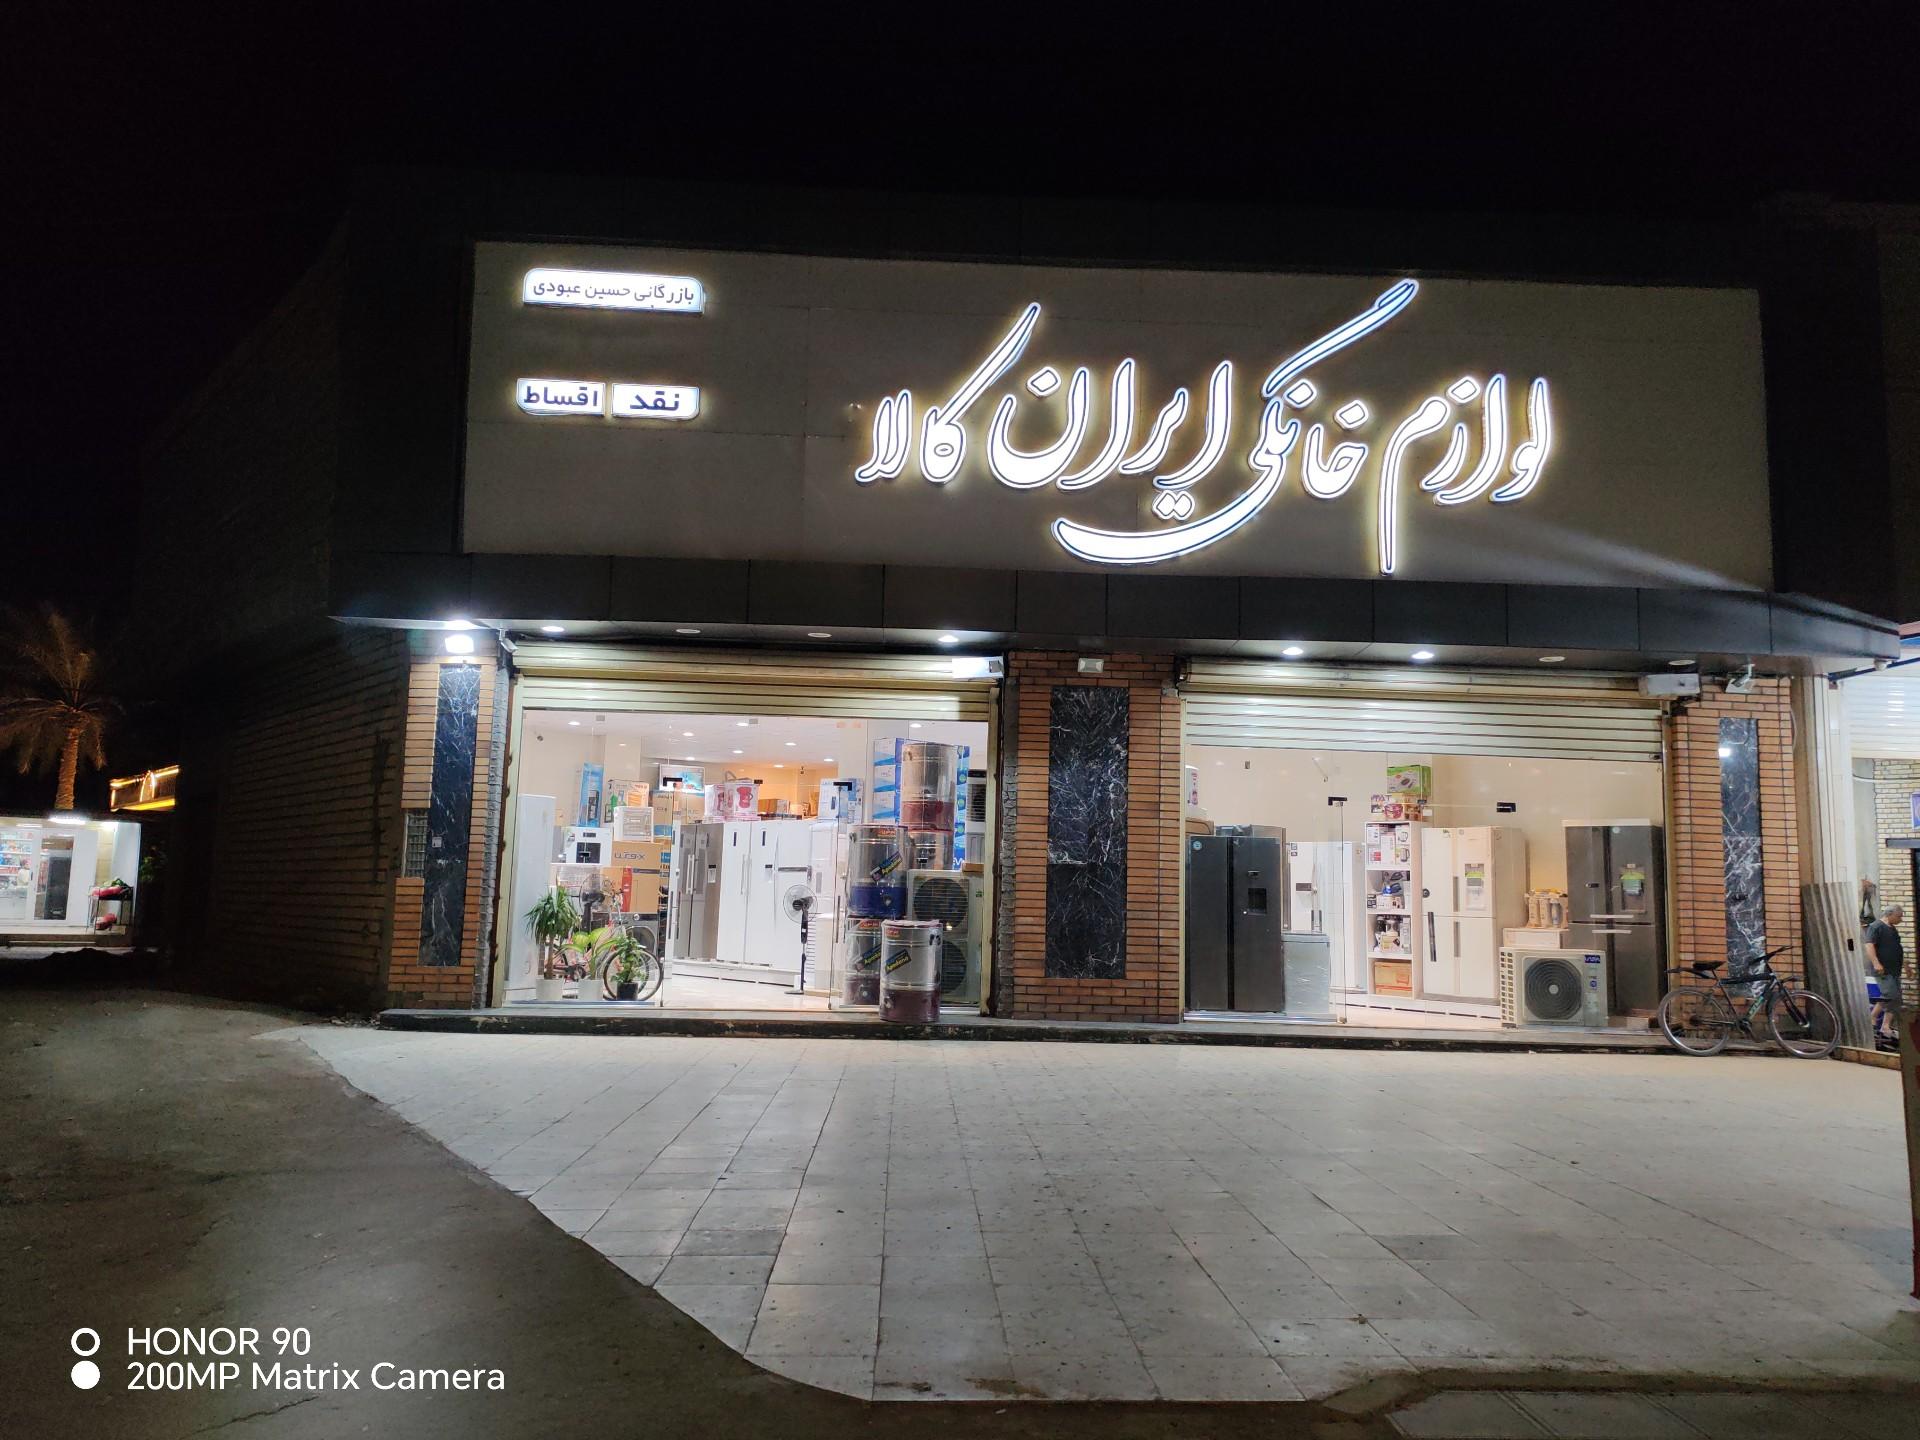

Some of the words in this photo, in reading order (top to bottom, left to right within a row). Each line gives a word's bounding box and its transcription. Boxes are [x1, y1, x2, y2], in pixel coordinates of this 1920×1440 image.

[532, 281, 581, 298] عبودی
[584, 285, 631, 300] حسین
[633, 283, 695, 305] بازرگانی
[523, 385, 598, 408] اقساط
[629, 390, 680, 412] نقد
[854, 302, 1042, 484] کالا
[1051, 275, 1420, 565] خانگی
[985, 357, 1234, 522] ایران
[1377, 373, 1552, 577] لوازم
